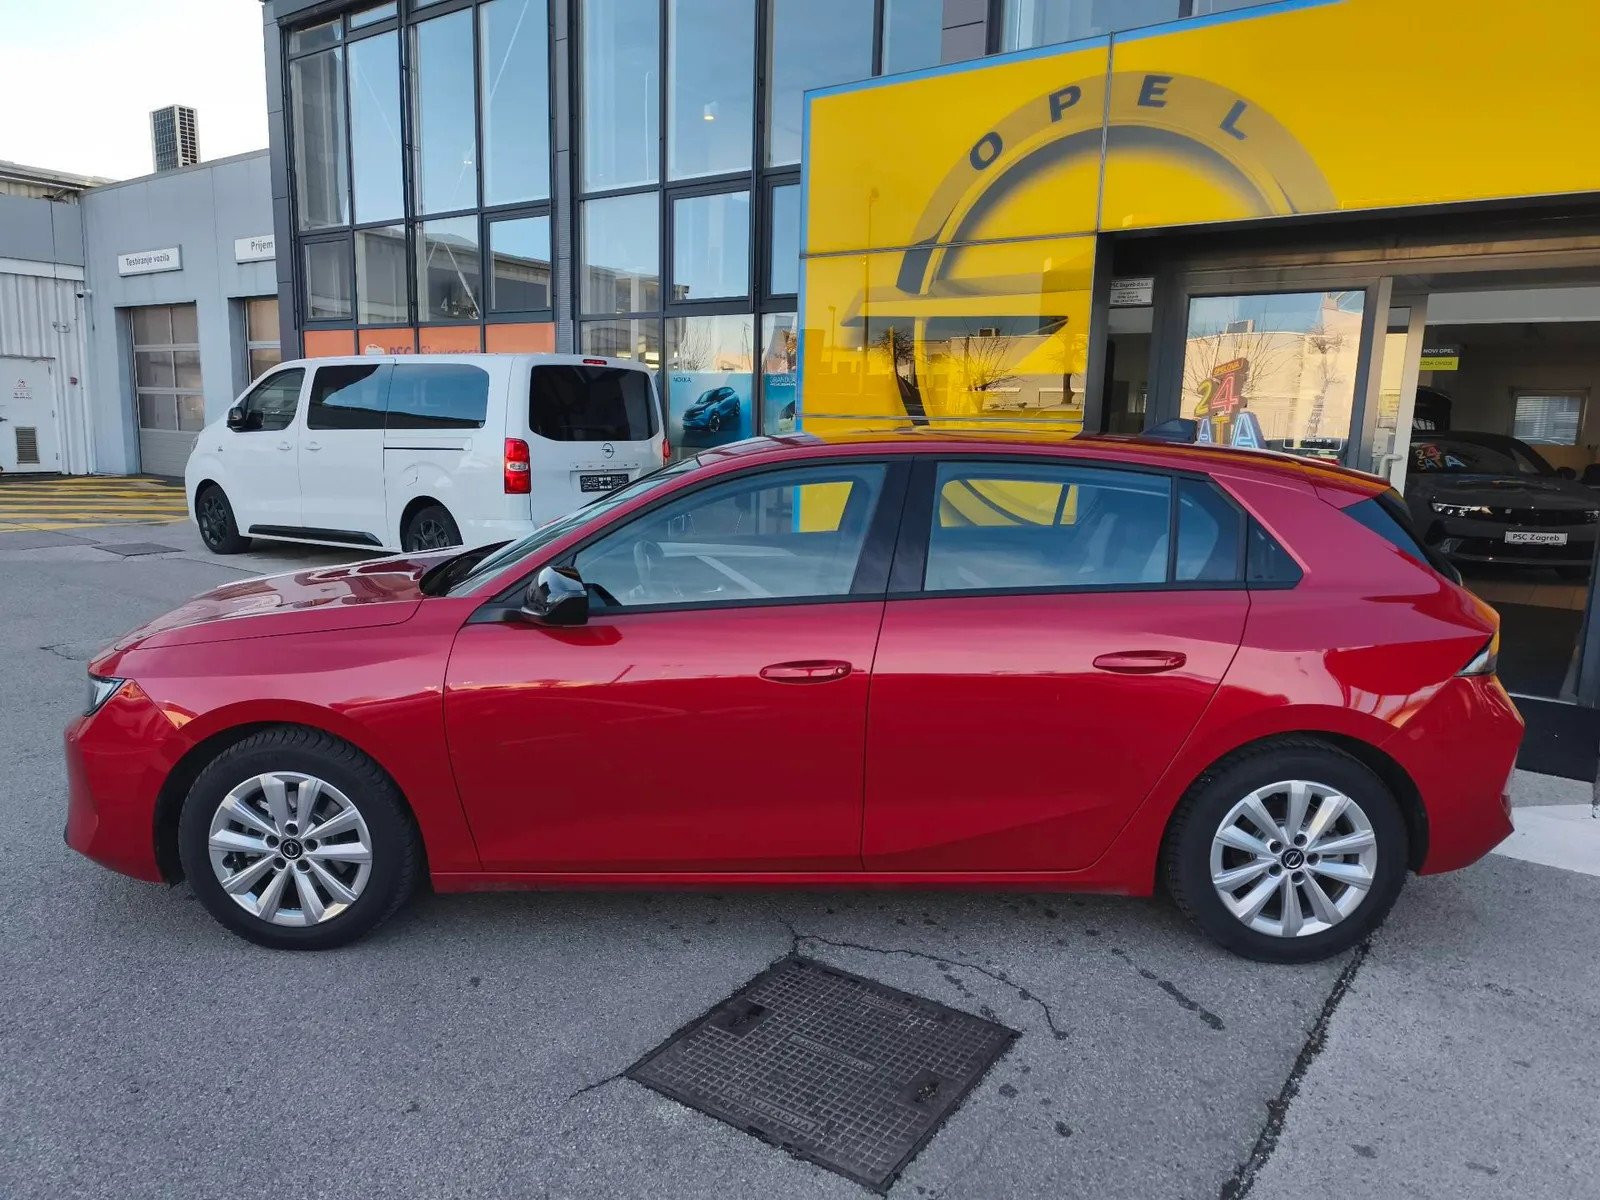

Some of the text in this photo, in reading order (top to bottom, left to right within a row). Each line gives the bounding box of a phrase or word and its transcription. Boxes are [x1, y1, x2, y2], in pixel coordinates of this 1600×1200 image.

[969, 73, 1250, 171] OPEL
[250, 239, 274, 253] Prijem
[125, 253, 170, 267] Testiranje vozila
[1193, 372, 1241, 416] 24
[1512, 533, 1560, 543] PSC Zagreb
